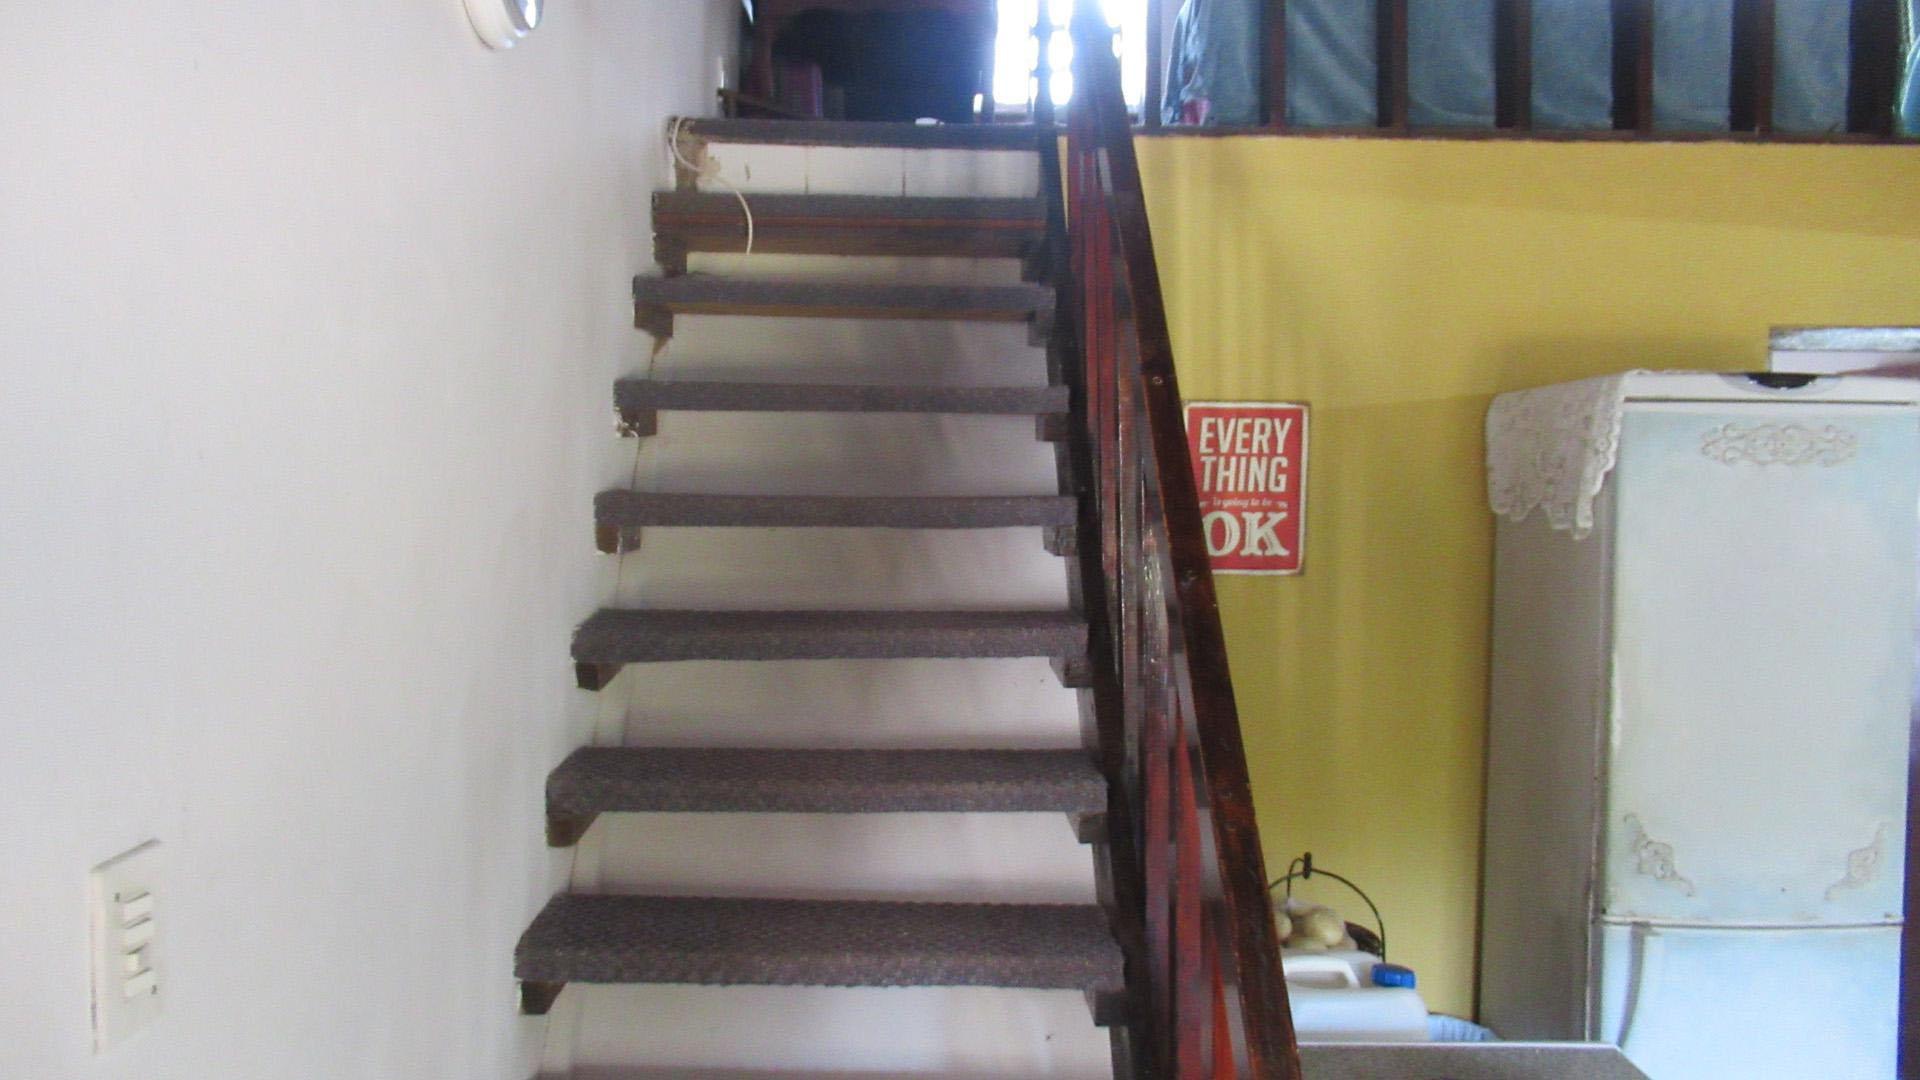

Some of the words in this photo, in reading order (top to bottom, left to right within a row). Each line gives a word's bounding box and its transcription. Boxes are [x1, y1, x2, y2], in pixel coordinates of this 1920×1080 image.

[1199, 417, 1292, 454] EVERY
[1200, 456, 1288, 492] THING
[1201, 511, 1290, 557] OK
